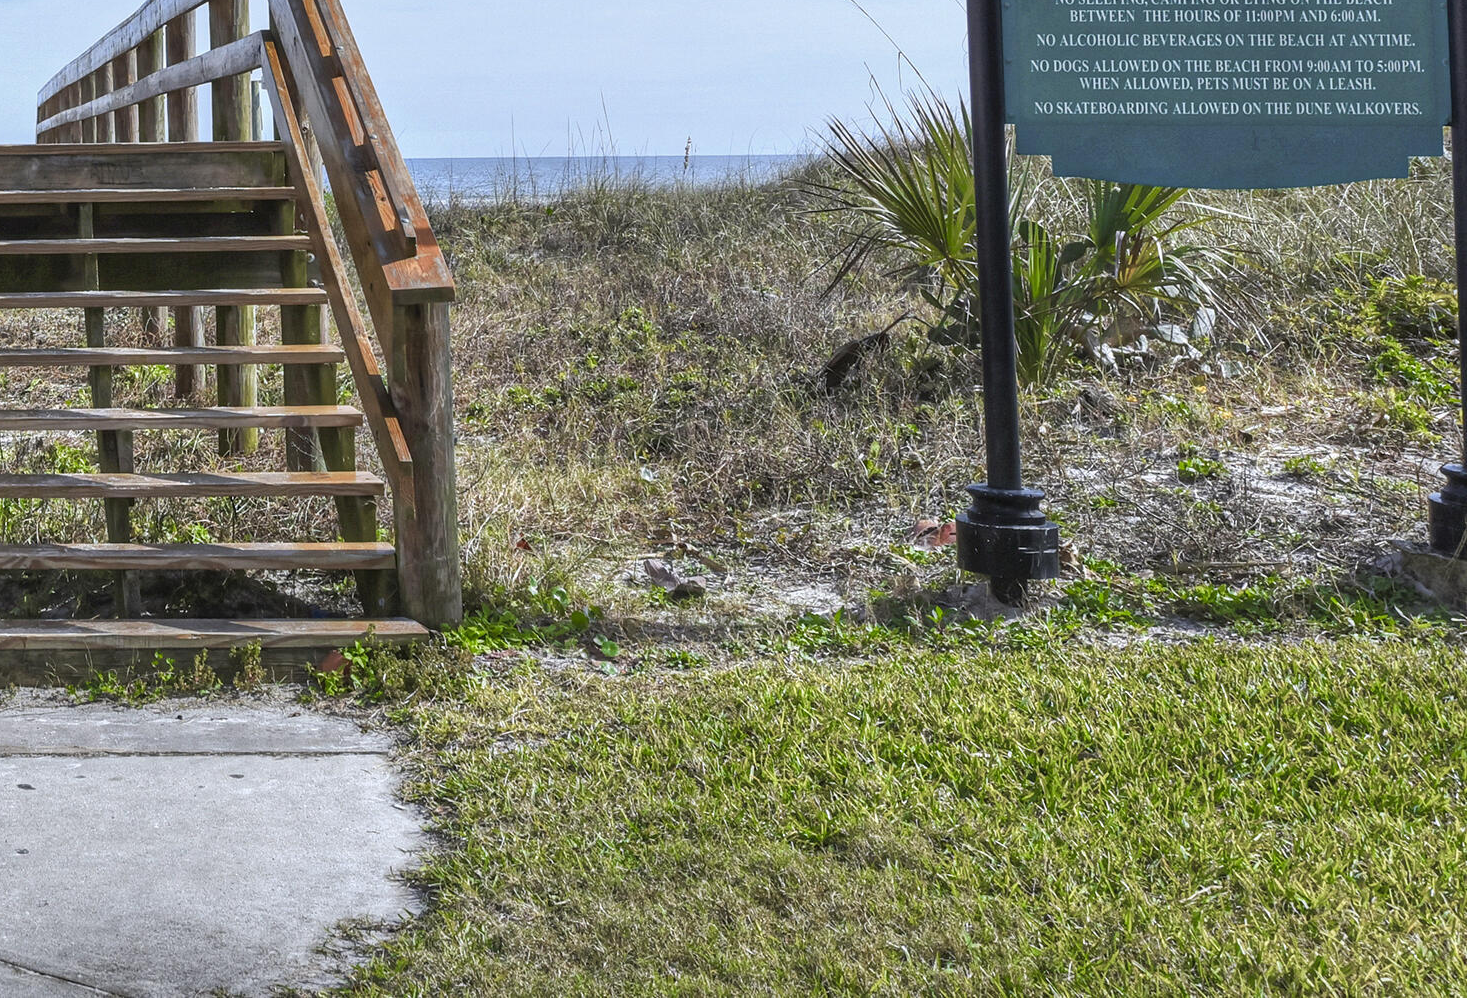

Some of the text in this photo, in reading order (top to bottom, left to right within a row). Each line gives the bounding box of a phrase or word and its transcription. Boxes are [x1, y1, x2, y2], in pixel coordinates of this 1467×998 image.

[1070, 10, 1135, 22] BETWEEN
[1143, 10, 1171, 22] THE
[1174, 10, 1220, 22] HOURS
[1224, 10, 1241, 22] OF
[1299, 10, 1327, 22] AND
[1036, 34, 1415, 47] NO ALCOHOLIC BEVERAGES ON THE BEACH AT ANYTIME.
[1031, 60, 1050, 72] NO
[1053, 60, 1089, 72] DOGS
[1093, 60, 1159, 72] ALLOWED
[1162, 60, 1182, 72] ON
[1185, 60, 1211, 72] THE
[1215, 60, 1260, 72] BEACH
[1265, 60, 1303, 72] FROM
[1356, 60, 1373, 72] TO
[1079, 77, 1376, 91] WHEN ALLOWED, PETS MUST BE ON A LEASH.
[1034, 102, 1422, 115] NO SKATEBOARDING ALLOWED ON THE DUNE WALKOVERS.
